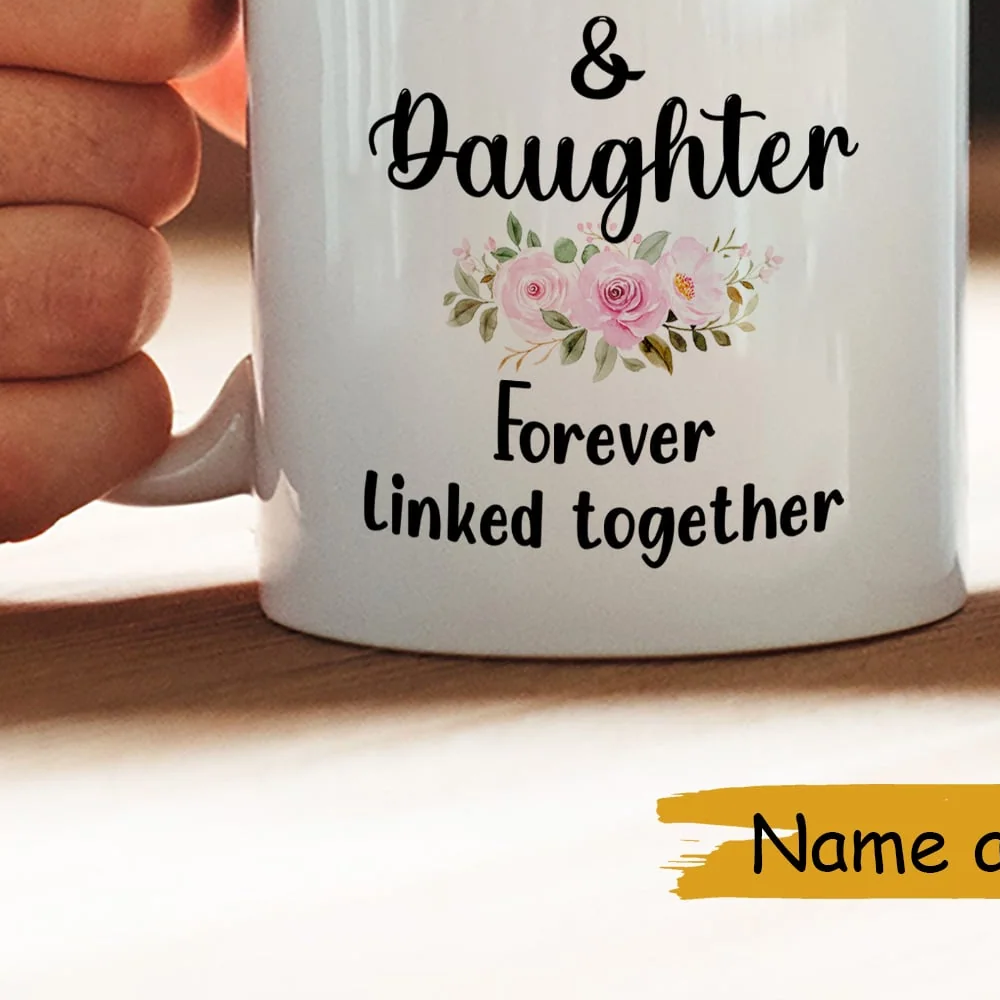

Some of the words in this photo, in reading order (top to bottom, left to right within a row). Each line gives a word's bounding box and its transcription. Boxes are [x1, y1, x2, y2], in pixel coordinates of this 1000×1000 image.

[570, 15, 646, 100] &
[368, 88, 859, 244] Daughter
[493, 379, 716, 466] Forever
[572, 483, 845, 569] together
